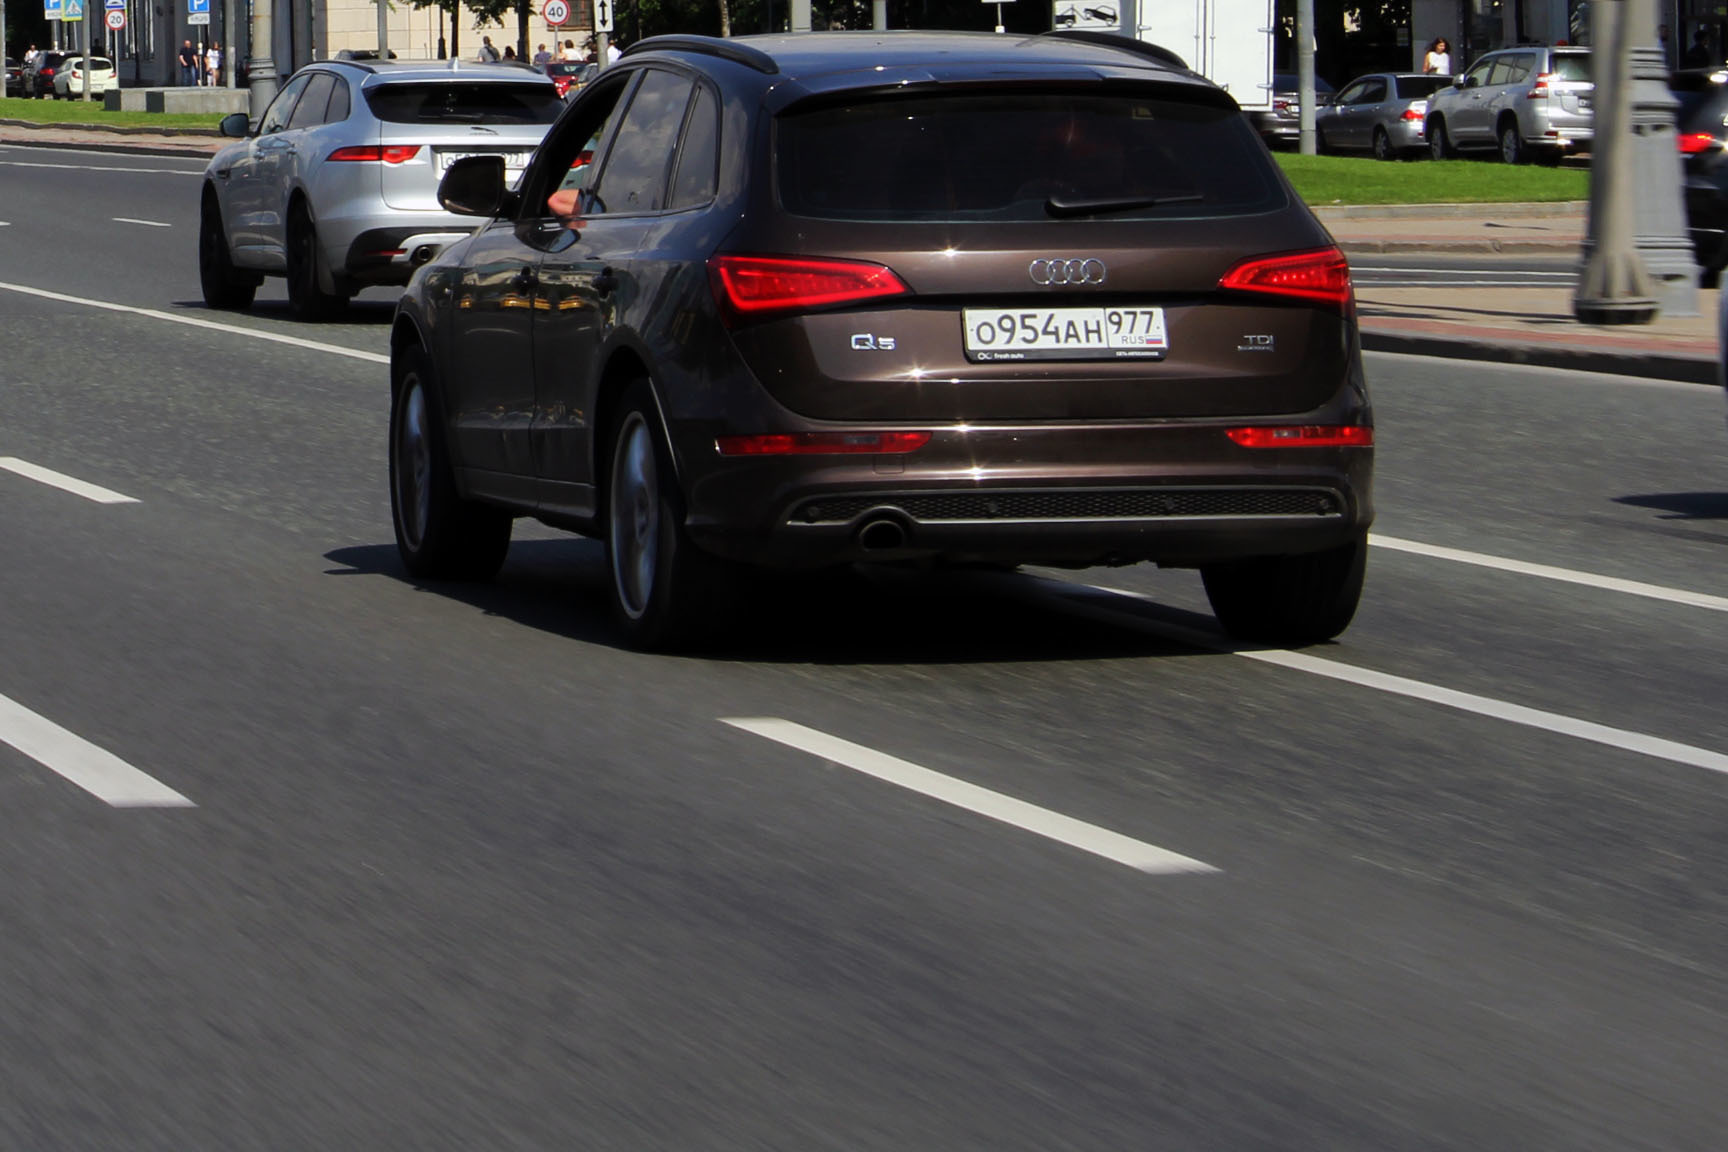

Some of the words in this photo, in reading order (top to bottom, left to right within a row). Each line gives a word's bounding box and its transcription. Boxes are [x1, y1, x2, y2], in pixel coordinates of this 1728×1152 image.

[548, 6, 564, 17] 40
[110, 15, 122, 24] 20
[975, 313, 1103, 345] О954АН
[1107, 311, 1154, 334] 977
[851, 333, 895, 350] Q5
[1121, 335, 1145, 344] RUS
[1243, 335, 1274, 345] TDI
